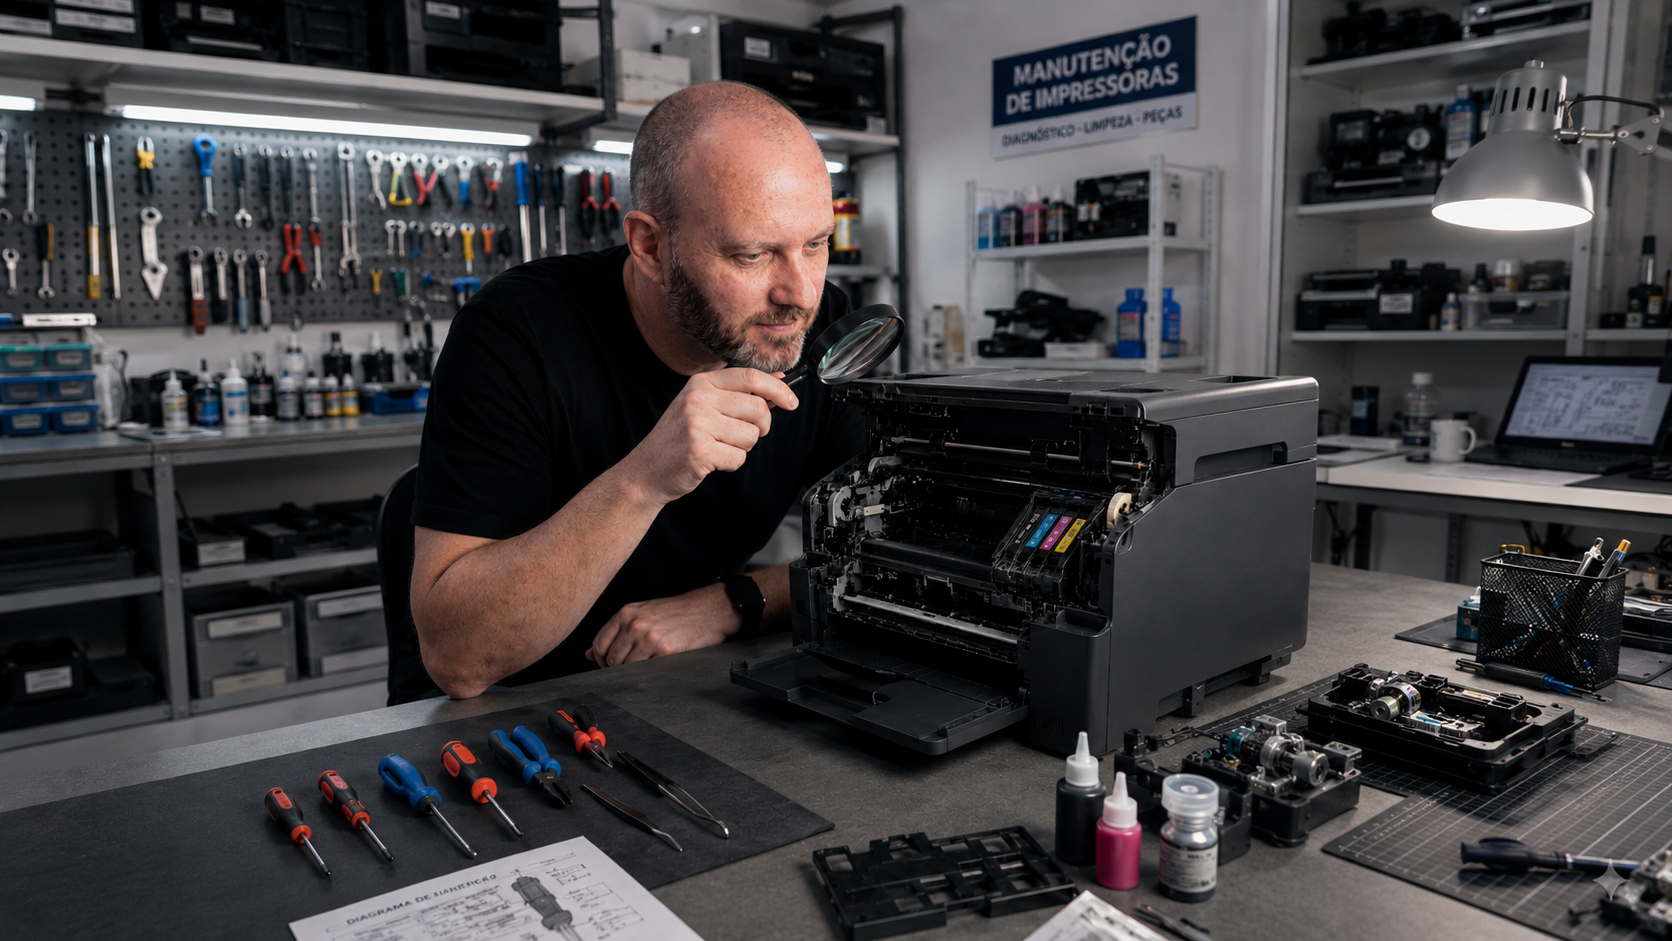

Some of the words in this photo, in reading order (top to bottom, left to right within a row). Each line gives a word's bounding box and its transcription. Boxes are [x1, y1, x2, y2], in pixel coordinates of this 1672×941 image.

[1014, 33, 1171, 86] MANUTENÇÃO
[1005, 93, 1032, 115] DE
[1035, 62, 1180, 110] IMPRESSORAS
[1002, 124, 1076, 147] DIAGNÓSTICO
[1084, 114, 1134, 134] LIMPEZA
[1142, 105, 1183, 125] PEÇAS
[346, 900, 413, 925] DIAGRAMA
[415, 894, 432, 903] DE
